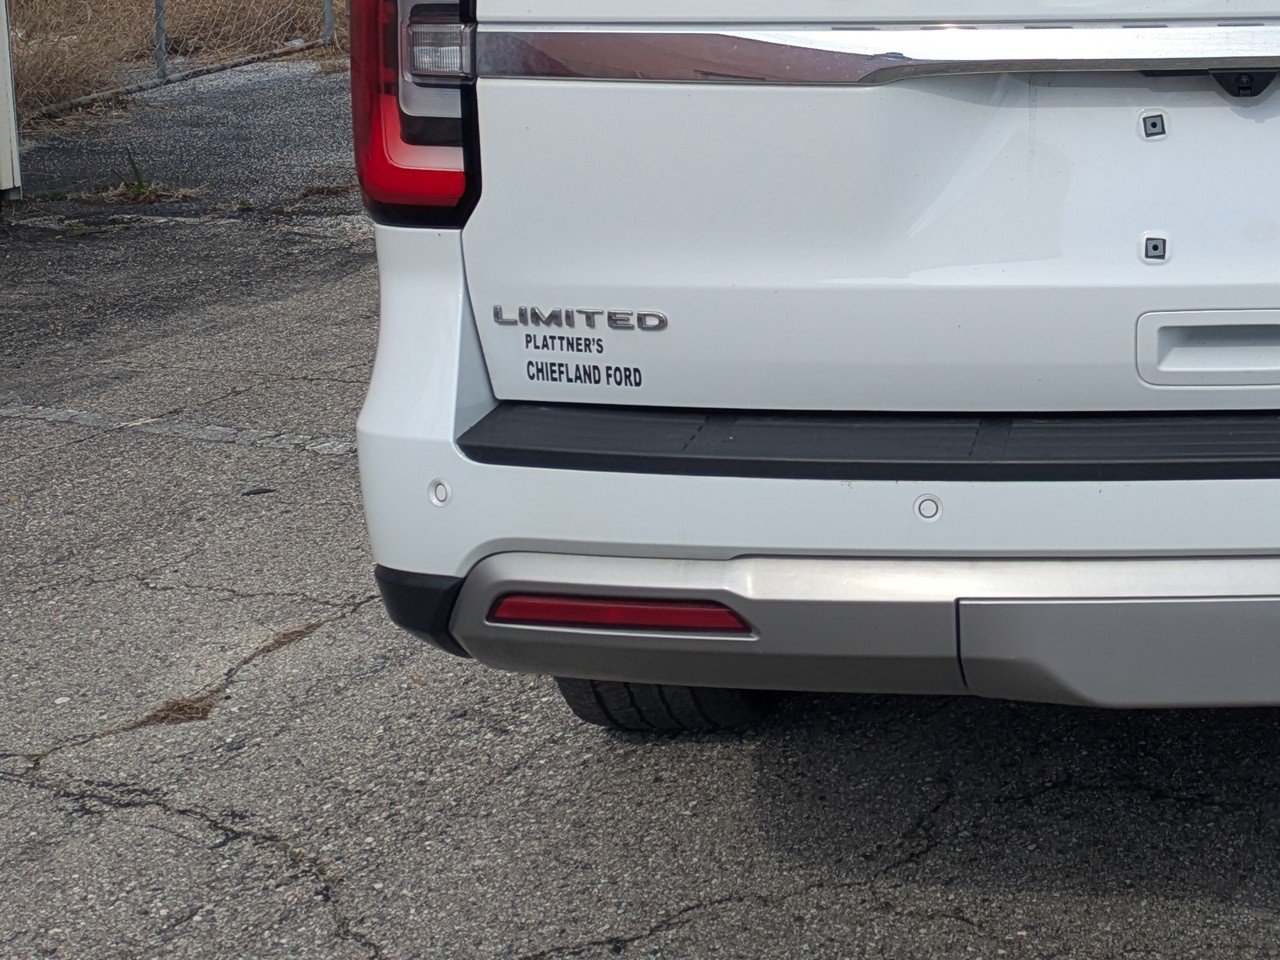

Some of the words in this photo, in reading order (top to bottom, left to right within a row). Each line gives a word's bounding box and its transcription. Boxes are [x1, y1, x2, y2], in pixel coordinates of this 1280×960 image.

[493, 305, 668, 331] LIMITED
[525, 334, 604, 354] PLATTNER'S
[527, 361, 600, 385] CHIEFLAND
[606, 366, 642, 387] FORD
